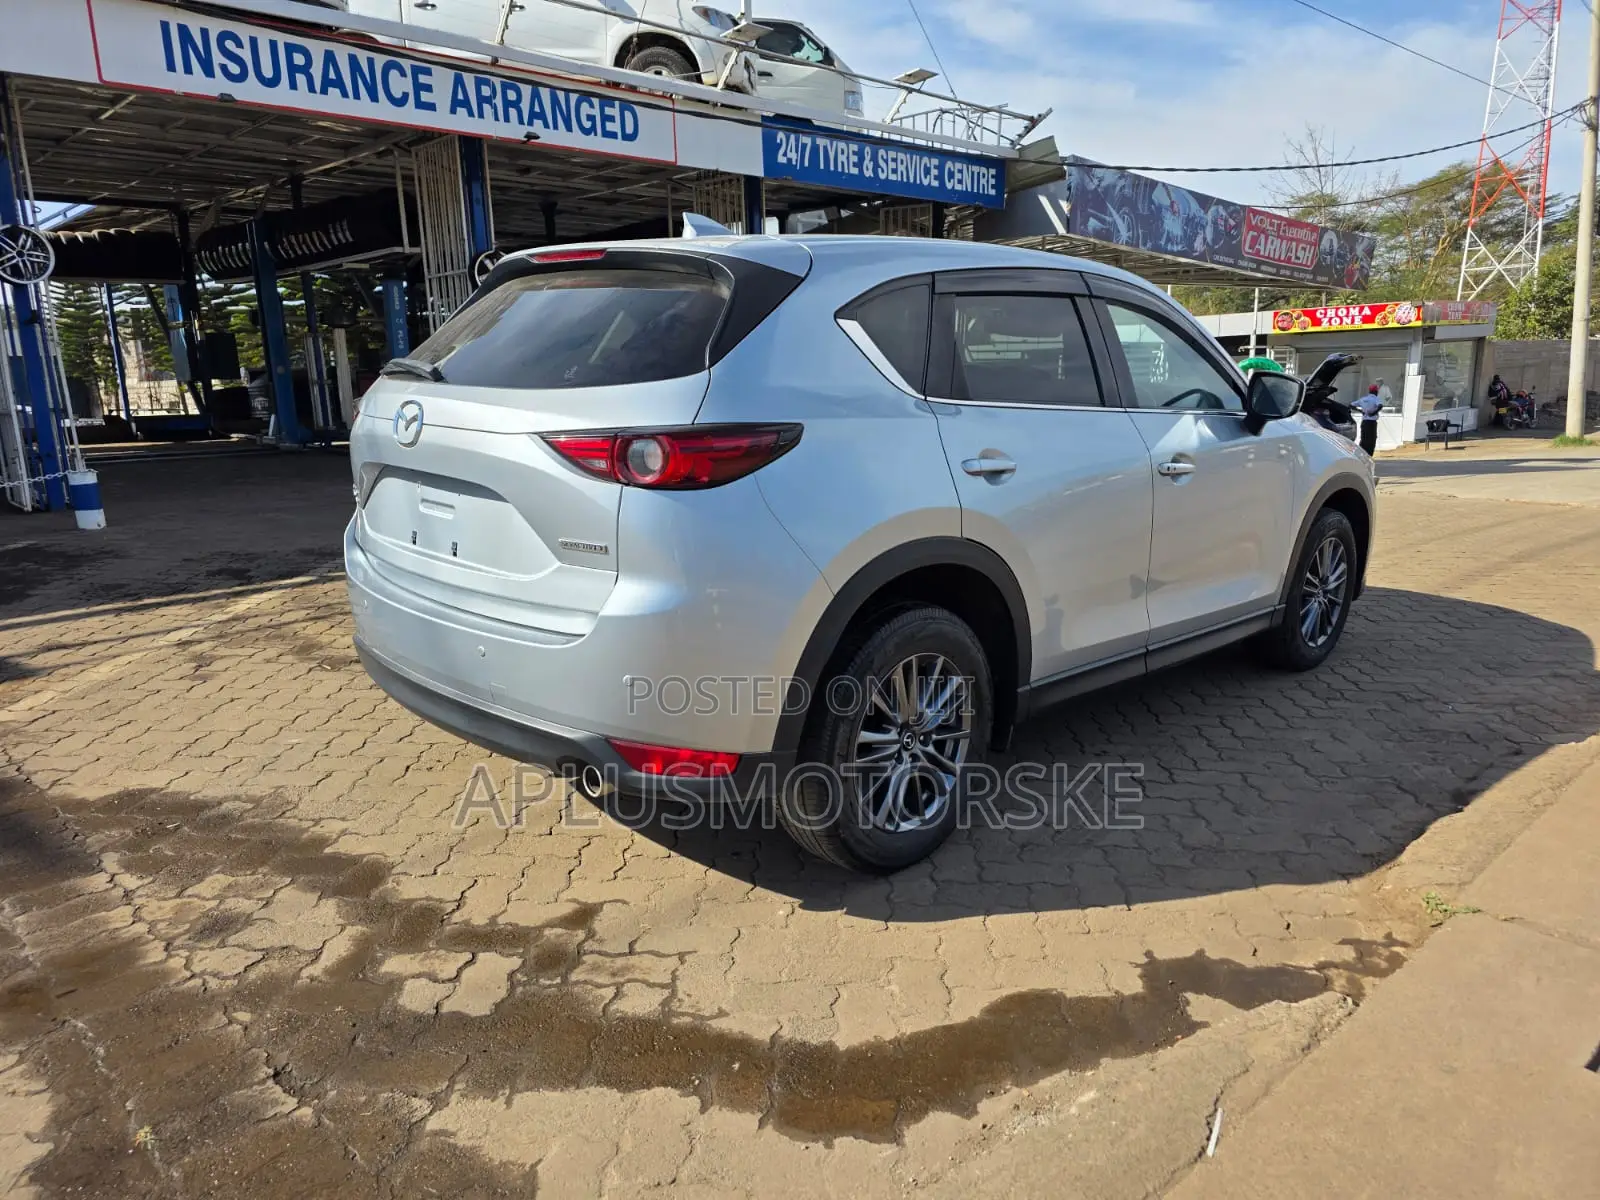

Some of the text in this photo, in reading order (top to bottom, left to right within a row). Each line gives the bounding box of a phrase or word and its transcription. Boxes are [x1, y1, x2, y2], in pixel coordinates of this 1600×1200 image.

[160, 20, 639, 142] INSURANCE ARRANGED
[776, 131, 996, 195] 24/7 TYRE & SERVICE CENTRE
[1250, 213, 1280, 231] VOLT
[1244, 231, 1315, 266] CARWASH
[1316, 306, 1371, 318] CHOMA
[1321, 316, 1363, 327] ZONE
